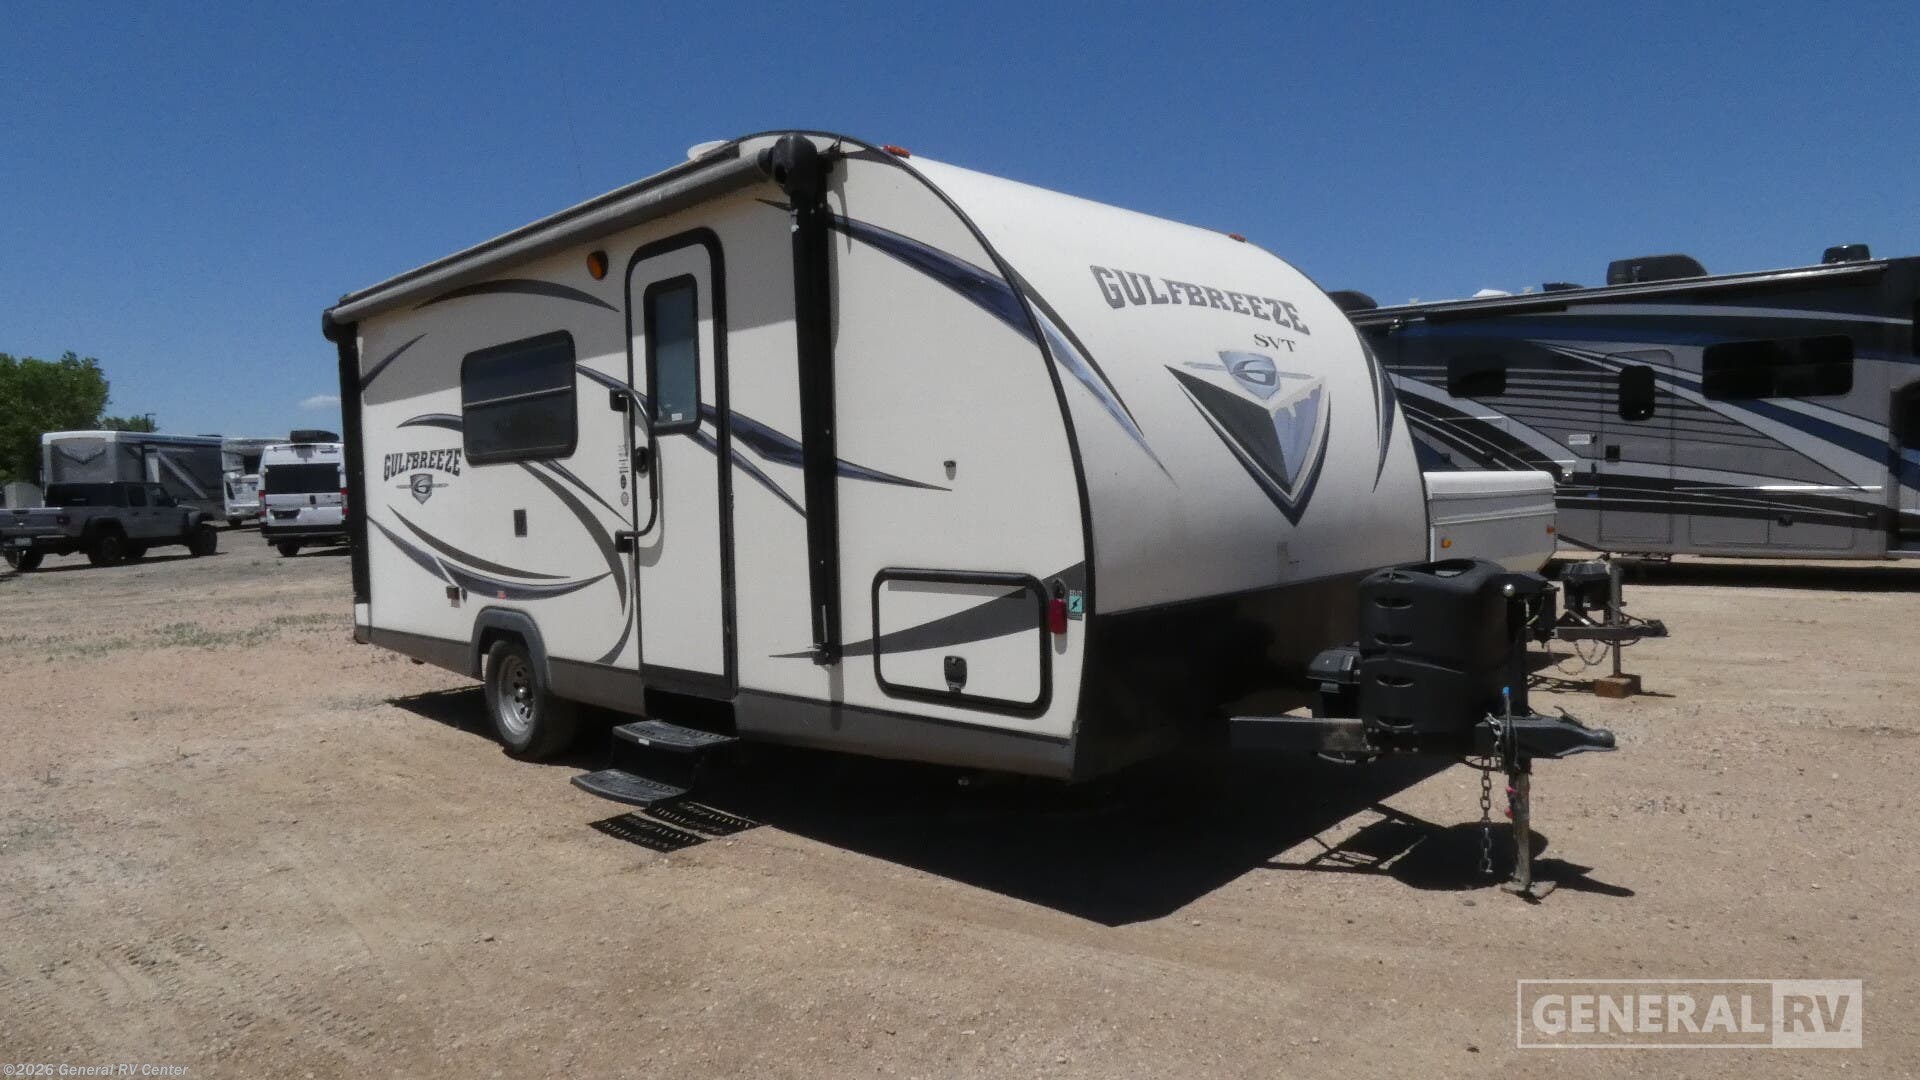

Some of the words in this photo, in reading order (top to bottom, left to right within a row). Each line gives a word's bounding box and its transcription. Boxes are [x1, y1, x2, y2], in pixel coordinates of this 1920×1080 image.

[1090, 264, 1311, 336] GULFBREEZE
[1253, 333, 1296, 353] SVT
[383, 447, 462, 482] GULFBREEZE
